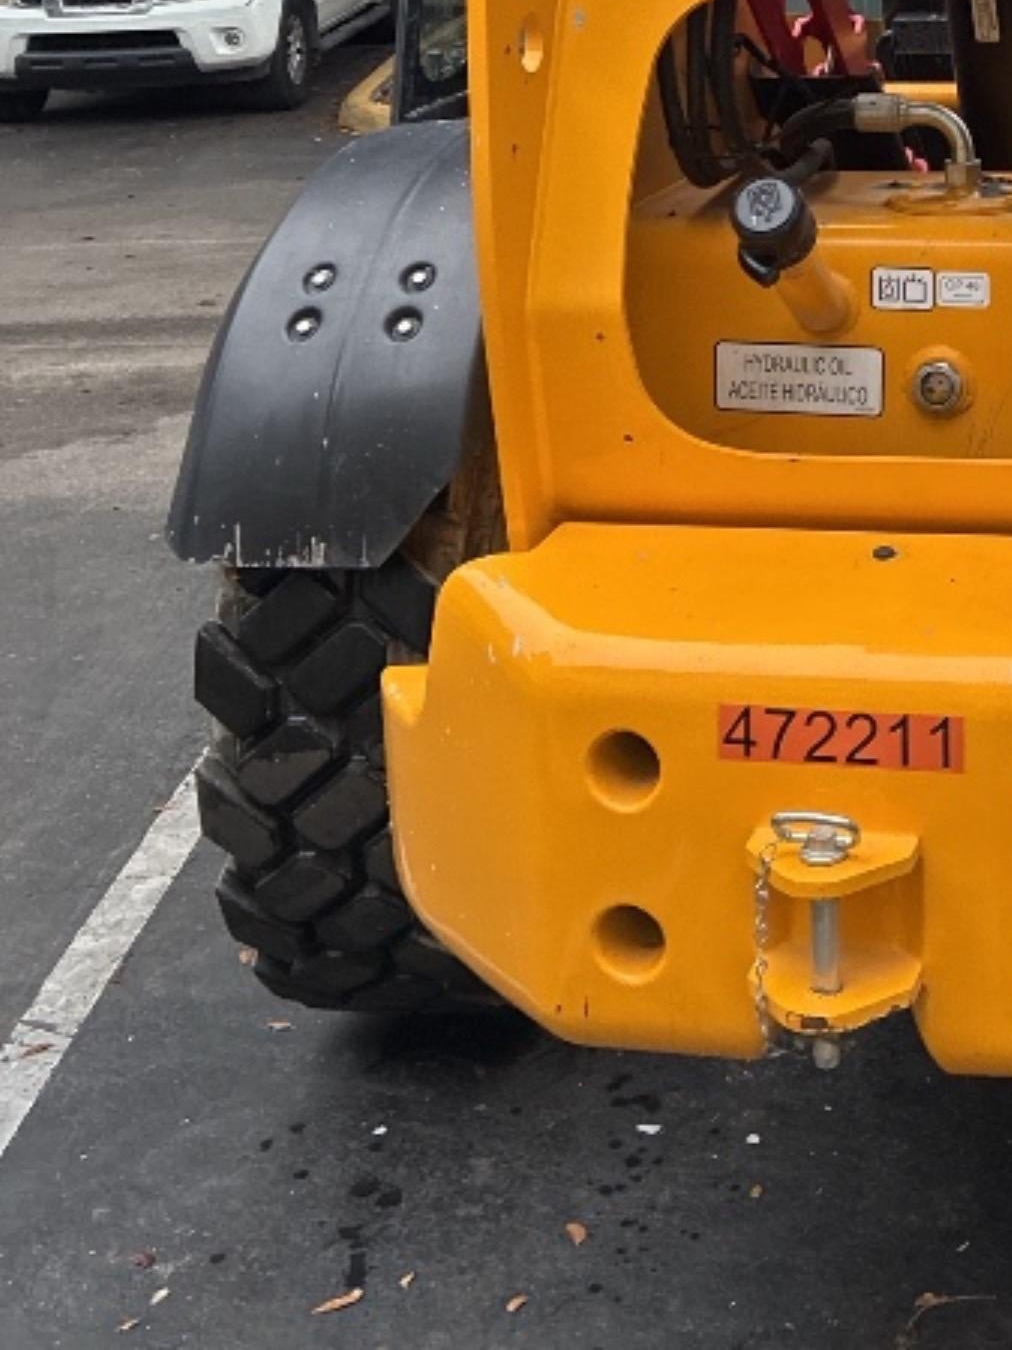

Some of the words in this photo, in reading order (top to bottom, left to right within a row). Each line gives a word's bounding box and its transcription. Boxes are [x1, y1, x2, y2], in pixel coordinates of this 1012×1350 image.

[743, 353, 825, 375] HYDRAULIC
[828, 356, 853, 376] OIL
[728, 381, 777, 400] ACEITE
[722, 706, 950, 769] 472211
